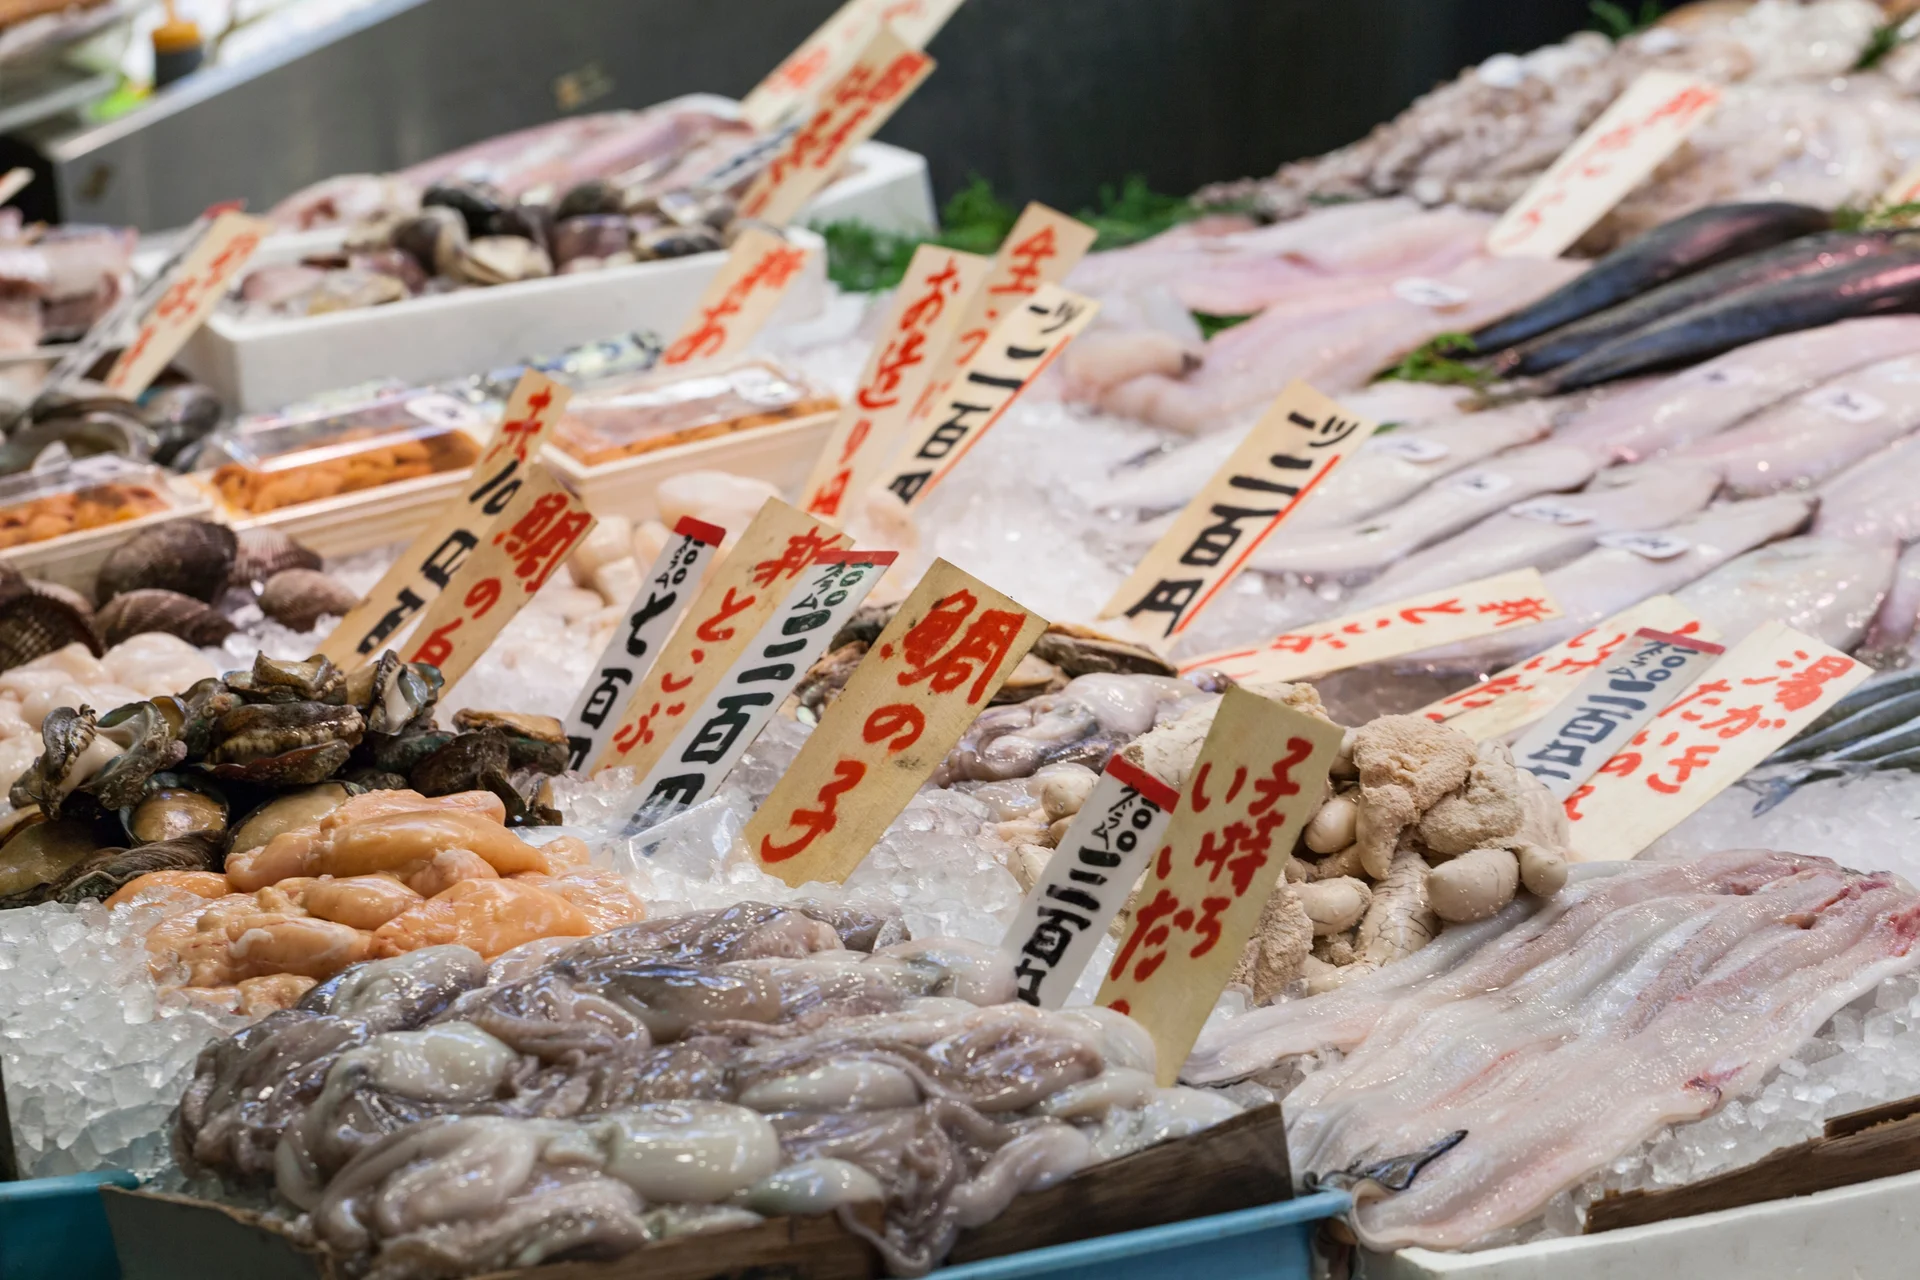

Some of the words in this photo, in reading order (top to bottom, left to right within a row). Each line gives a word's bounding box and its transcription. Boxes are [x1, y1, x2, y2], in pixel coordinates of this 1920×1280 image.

[604, 526, 844, 770] 新とこぶ
[760, 588, 1028, 864] 鯛の子
[1645, 650, 1855, 795] 湯がき
